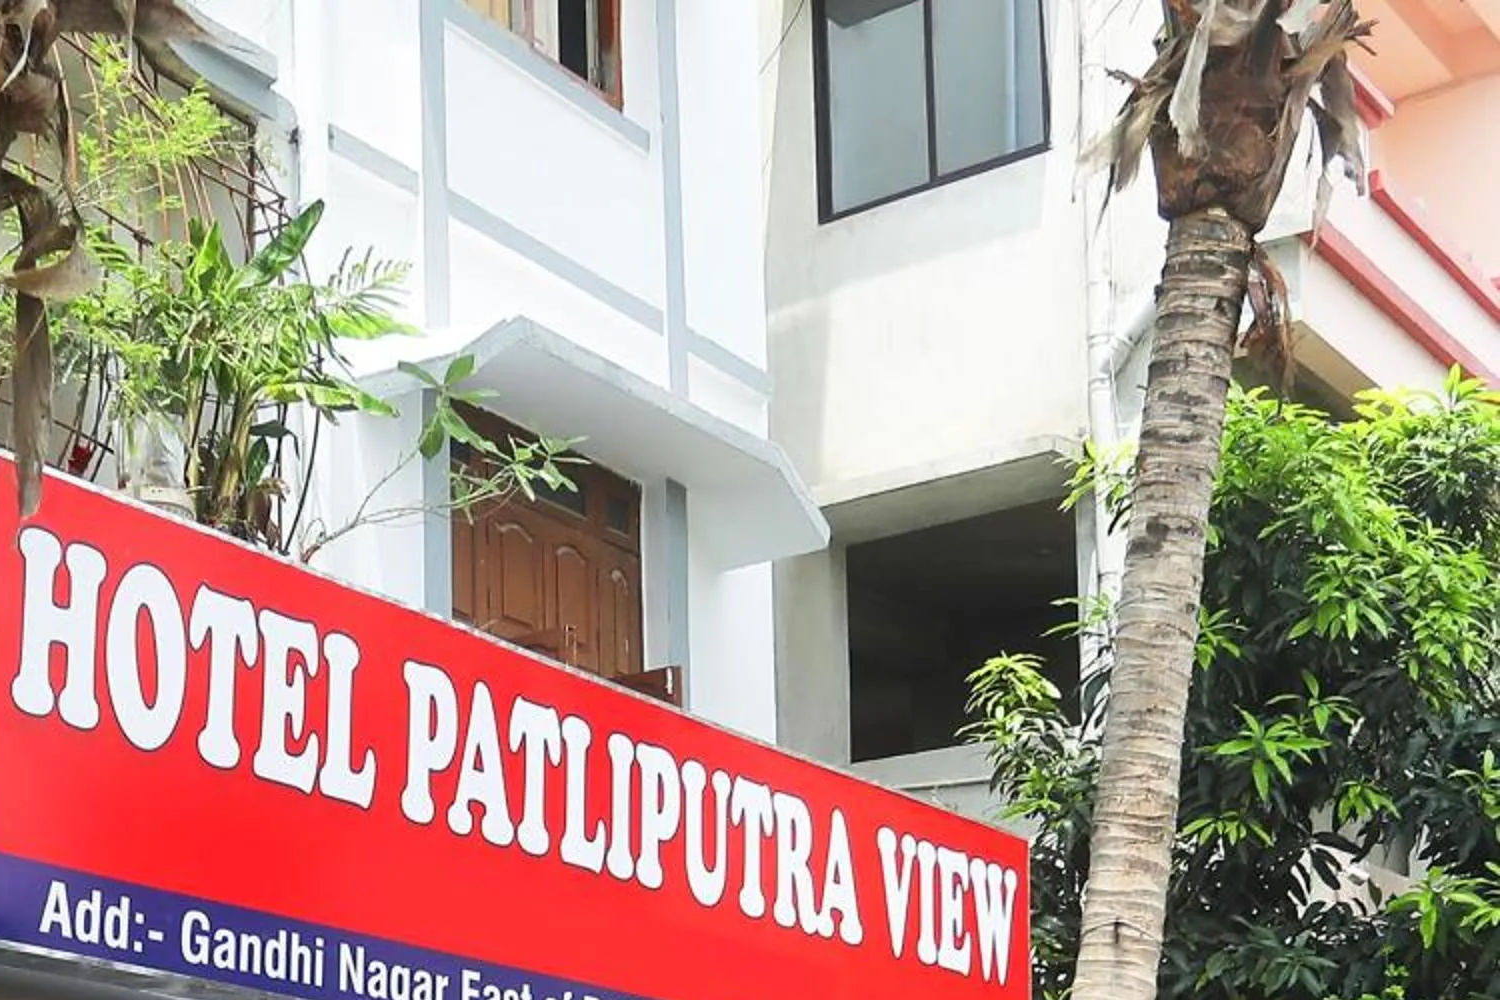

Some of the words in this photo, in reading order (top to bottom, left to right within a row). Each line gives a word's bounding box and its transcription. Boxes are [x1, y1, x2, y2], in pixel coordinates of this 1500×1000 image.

[11, 526, 377, 811] HOTEL
[400, 658, 864, 946] PATLIPUTRA
[877, 827, 1018, 986] VIEW
[181, 910, 324, 987] Gandhi
